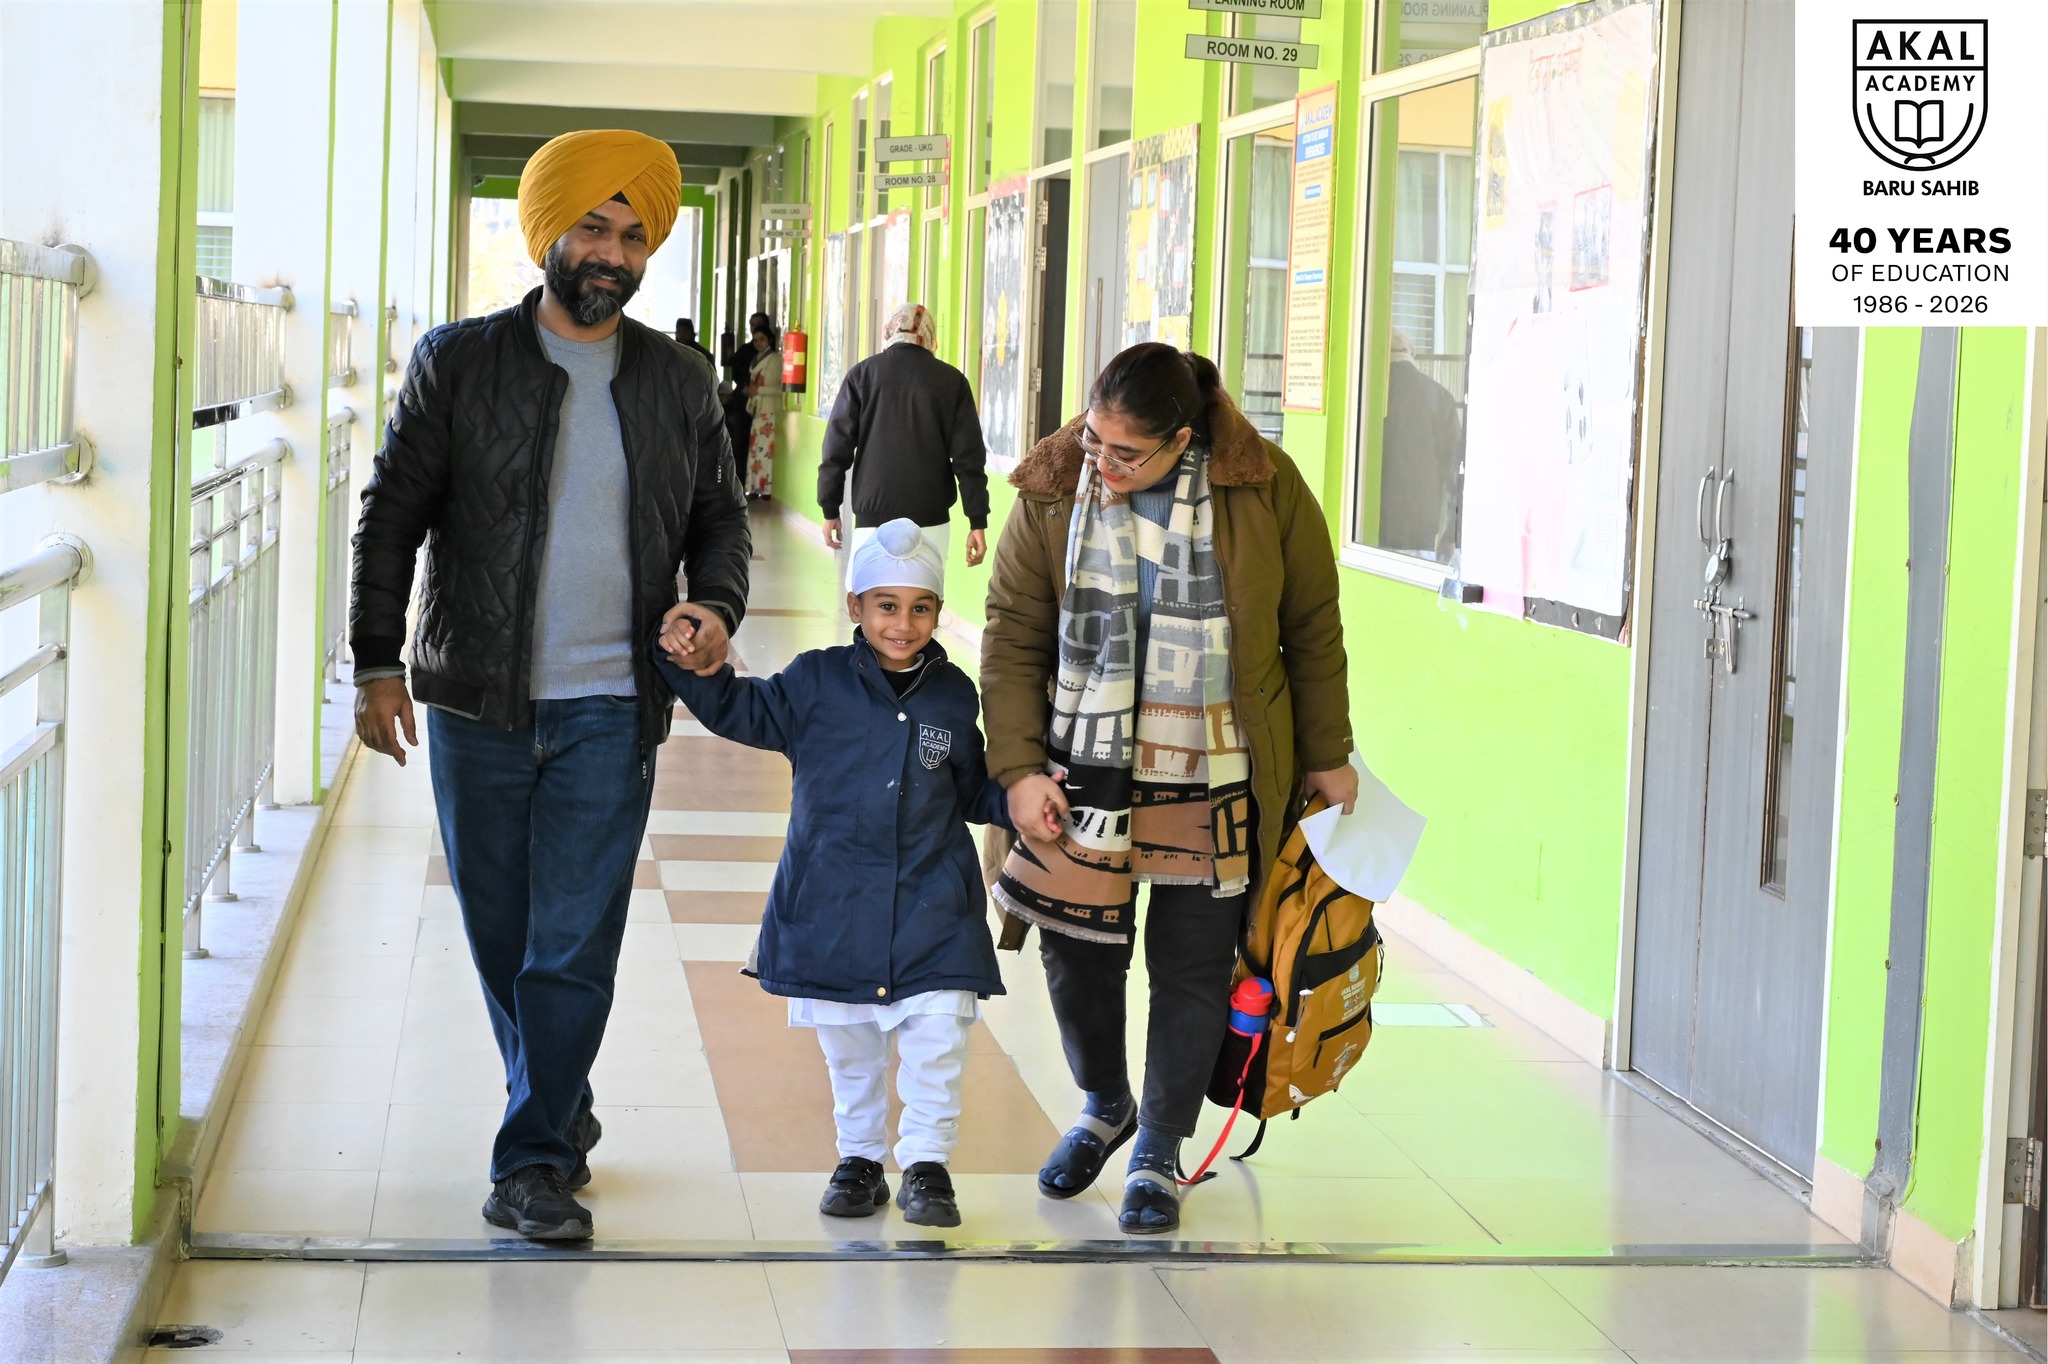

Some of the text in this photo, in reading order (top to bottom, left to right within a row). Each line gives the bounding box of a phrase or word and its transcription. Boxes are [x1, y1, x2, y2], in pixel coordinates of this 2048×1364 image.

[1207, 0, 1305, 11] NNING ROOM
[1206, 41, 1298, 61] ROOM NO. 29
[890, 144, 913, 153] GRADE
[918, 143, 933, 152] UKG
[885, 175, 936, 186] ROOM NO. 28
[922, 728, 948, 743] AKAL
[921, 741, 948, 752] ACADEMY
